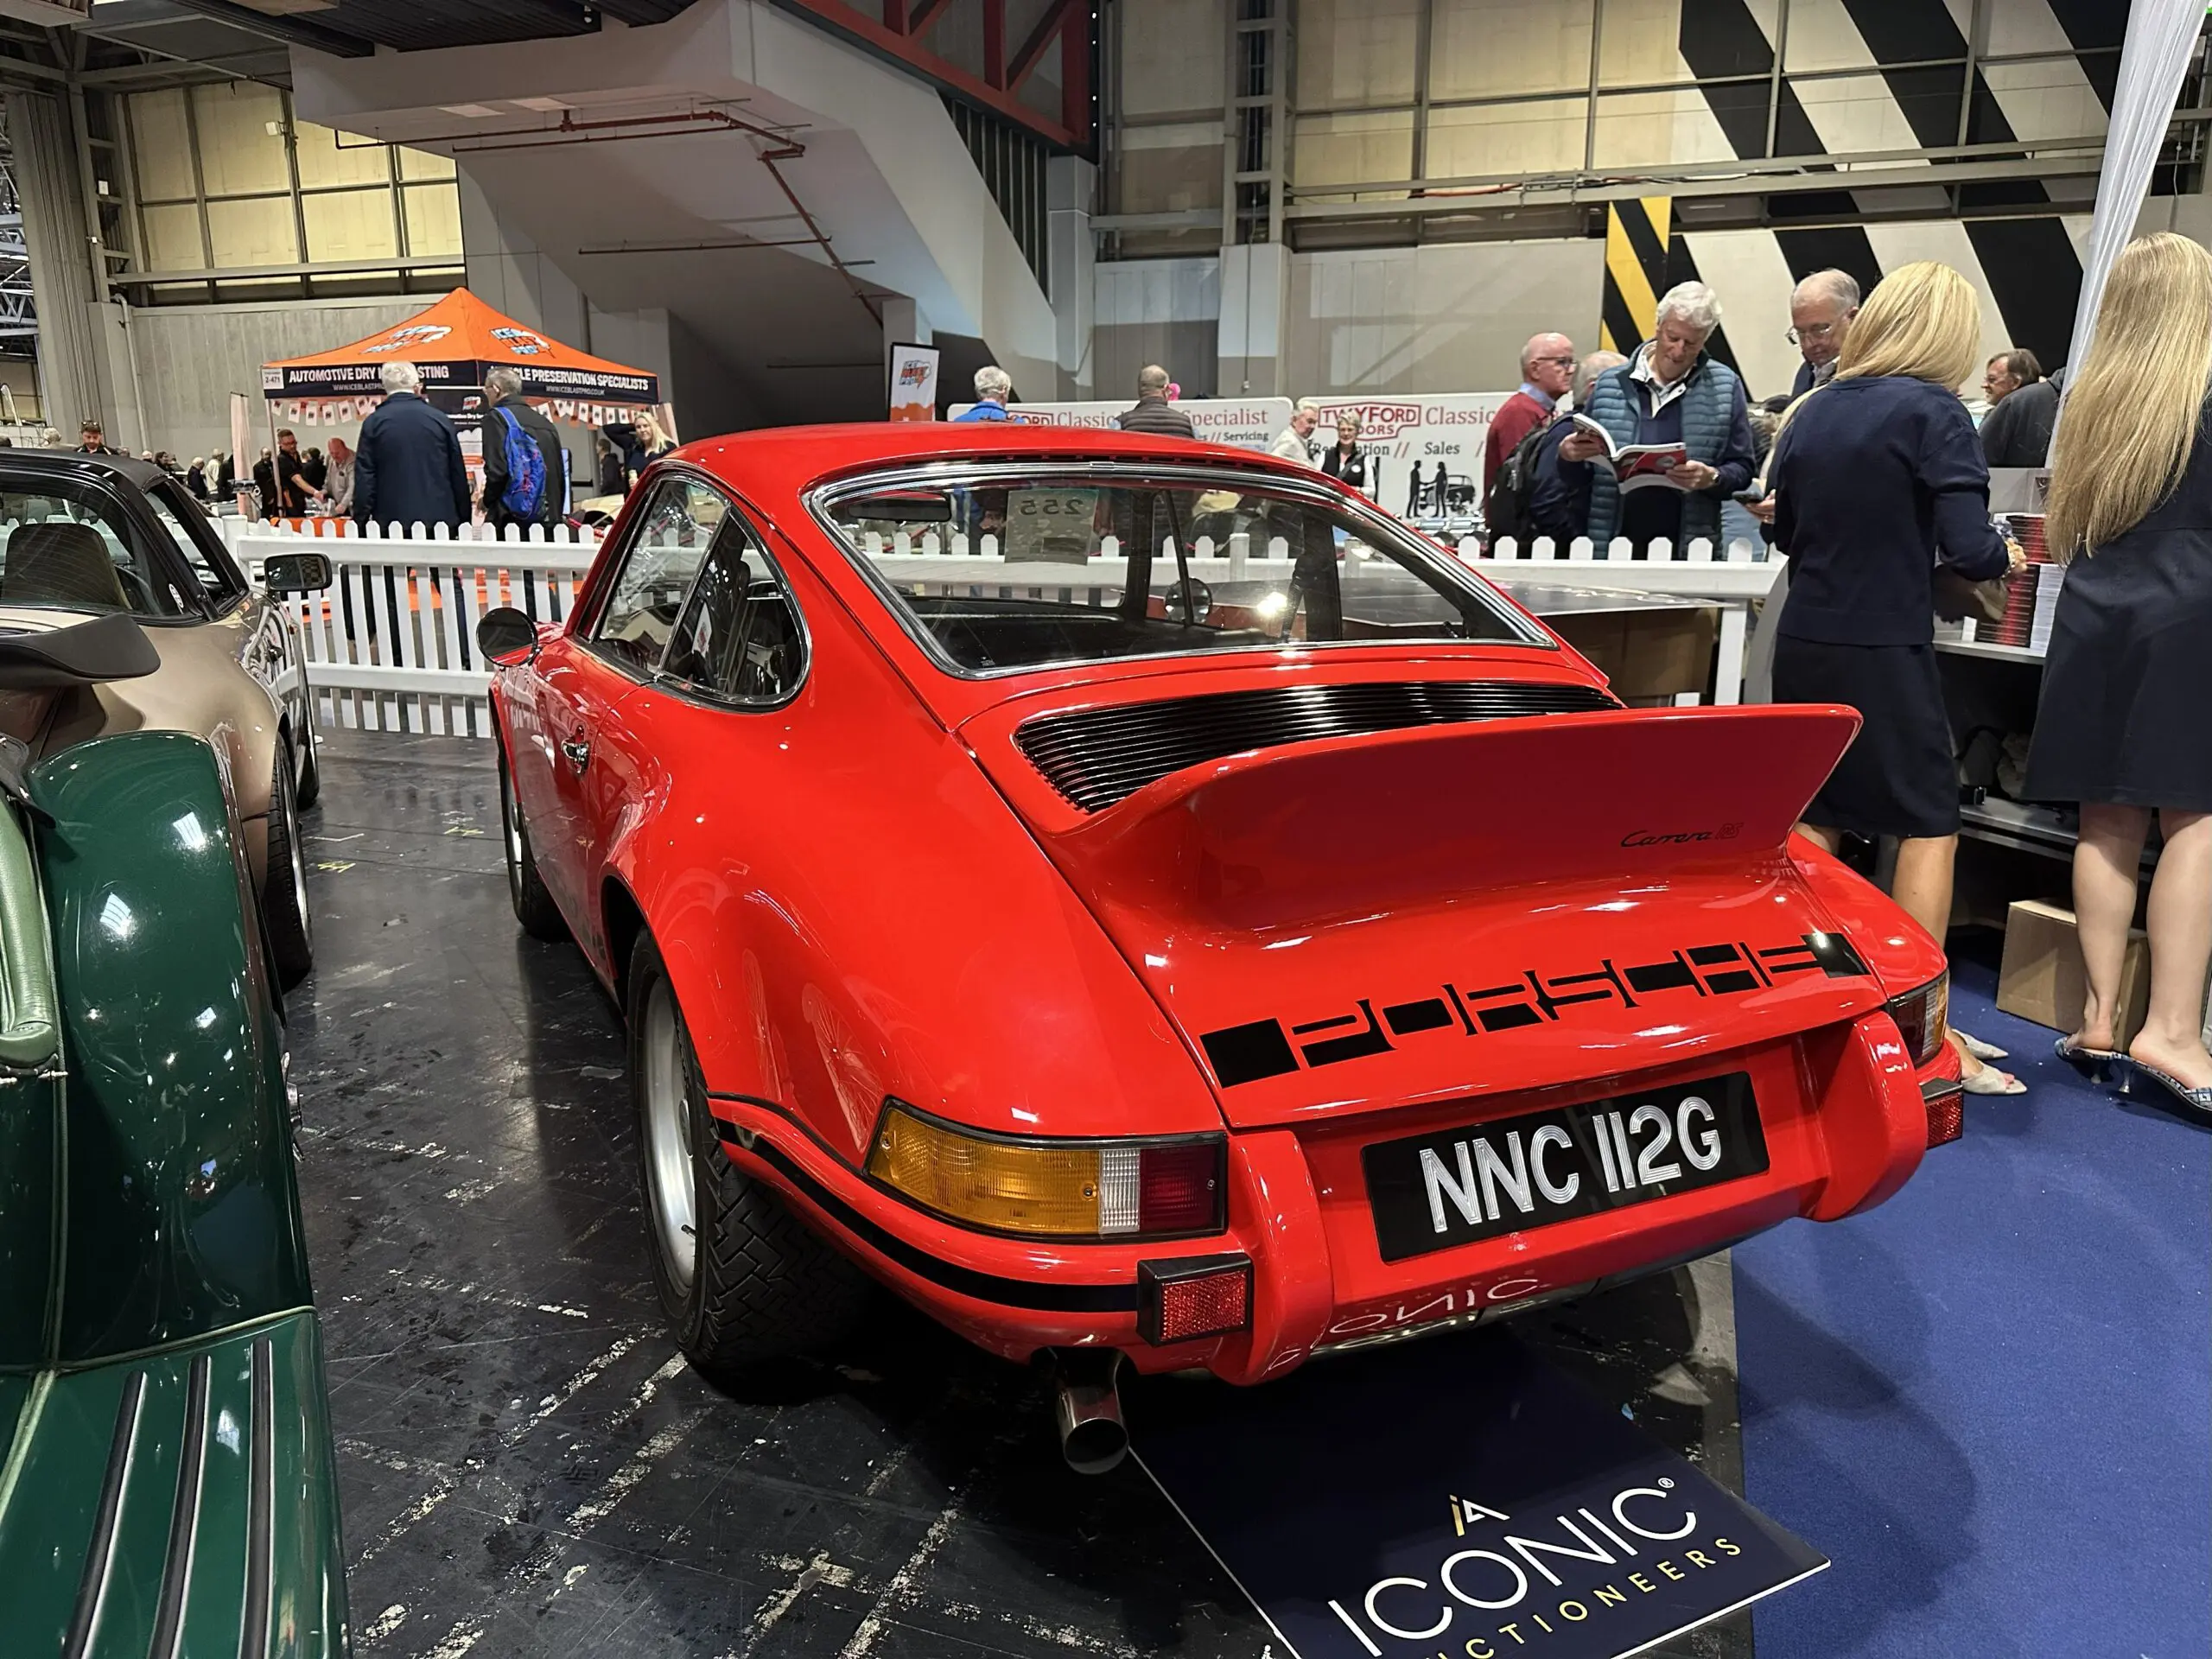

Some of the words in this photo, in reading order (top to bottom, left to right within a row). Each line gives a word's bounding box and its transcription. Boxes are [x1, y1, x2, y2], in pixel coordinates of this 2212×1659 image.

[289, 367, 354, 383] AUTOMOTIVE
[355, 366, 376, 380] DRY
[531, 368, 597, 386] PRESERVATION
[597, 375, 648, 391] SPECIALISTS
[1224, 433, 1269, 442] Servicing
[1425, 442, 1460, 454] Sales
[1620, 830, 1713, 848] Carrera
[1270, 935, 1840, 1078] PORSCHE
[1419, 1124, 1580, 1233] NNC
[1592, 1096, 1722, 1193] 112G
